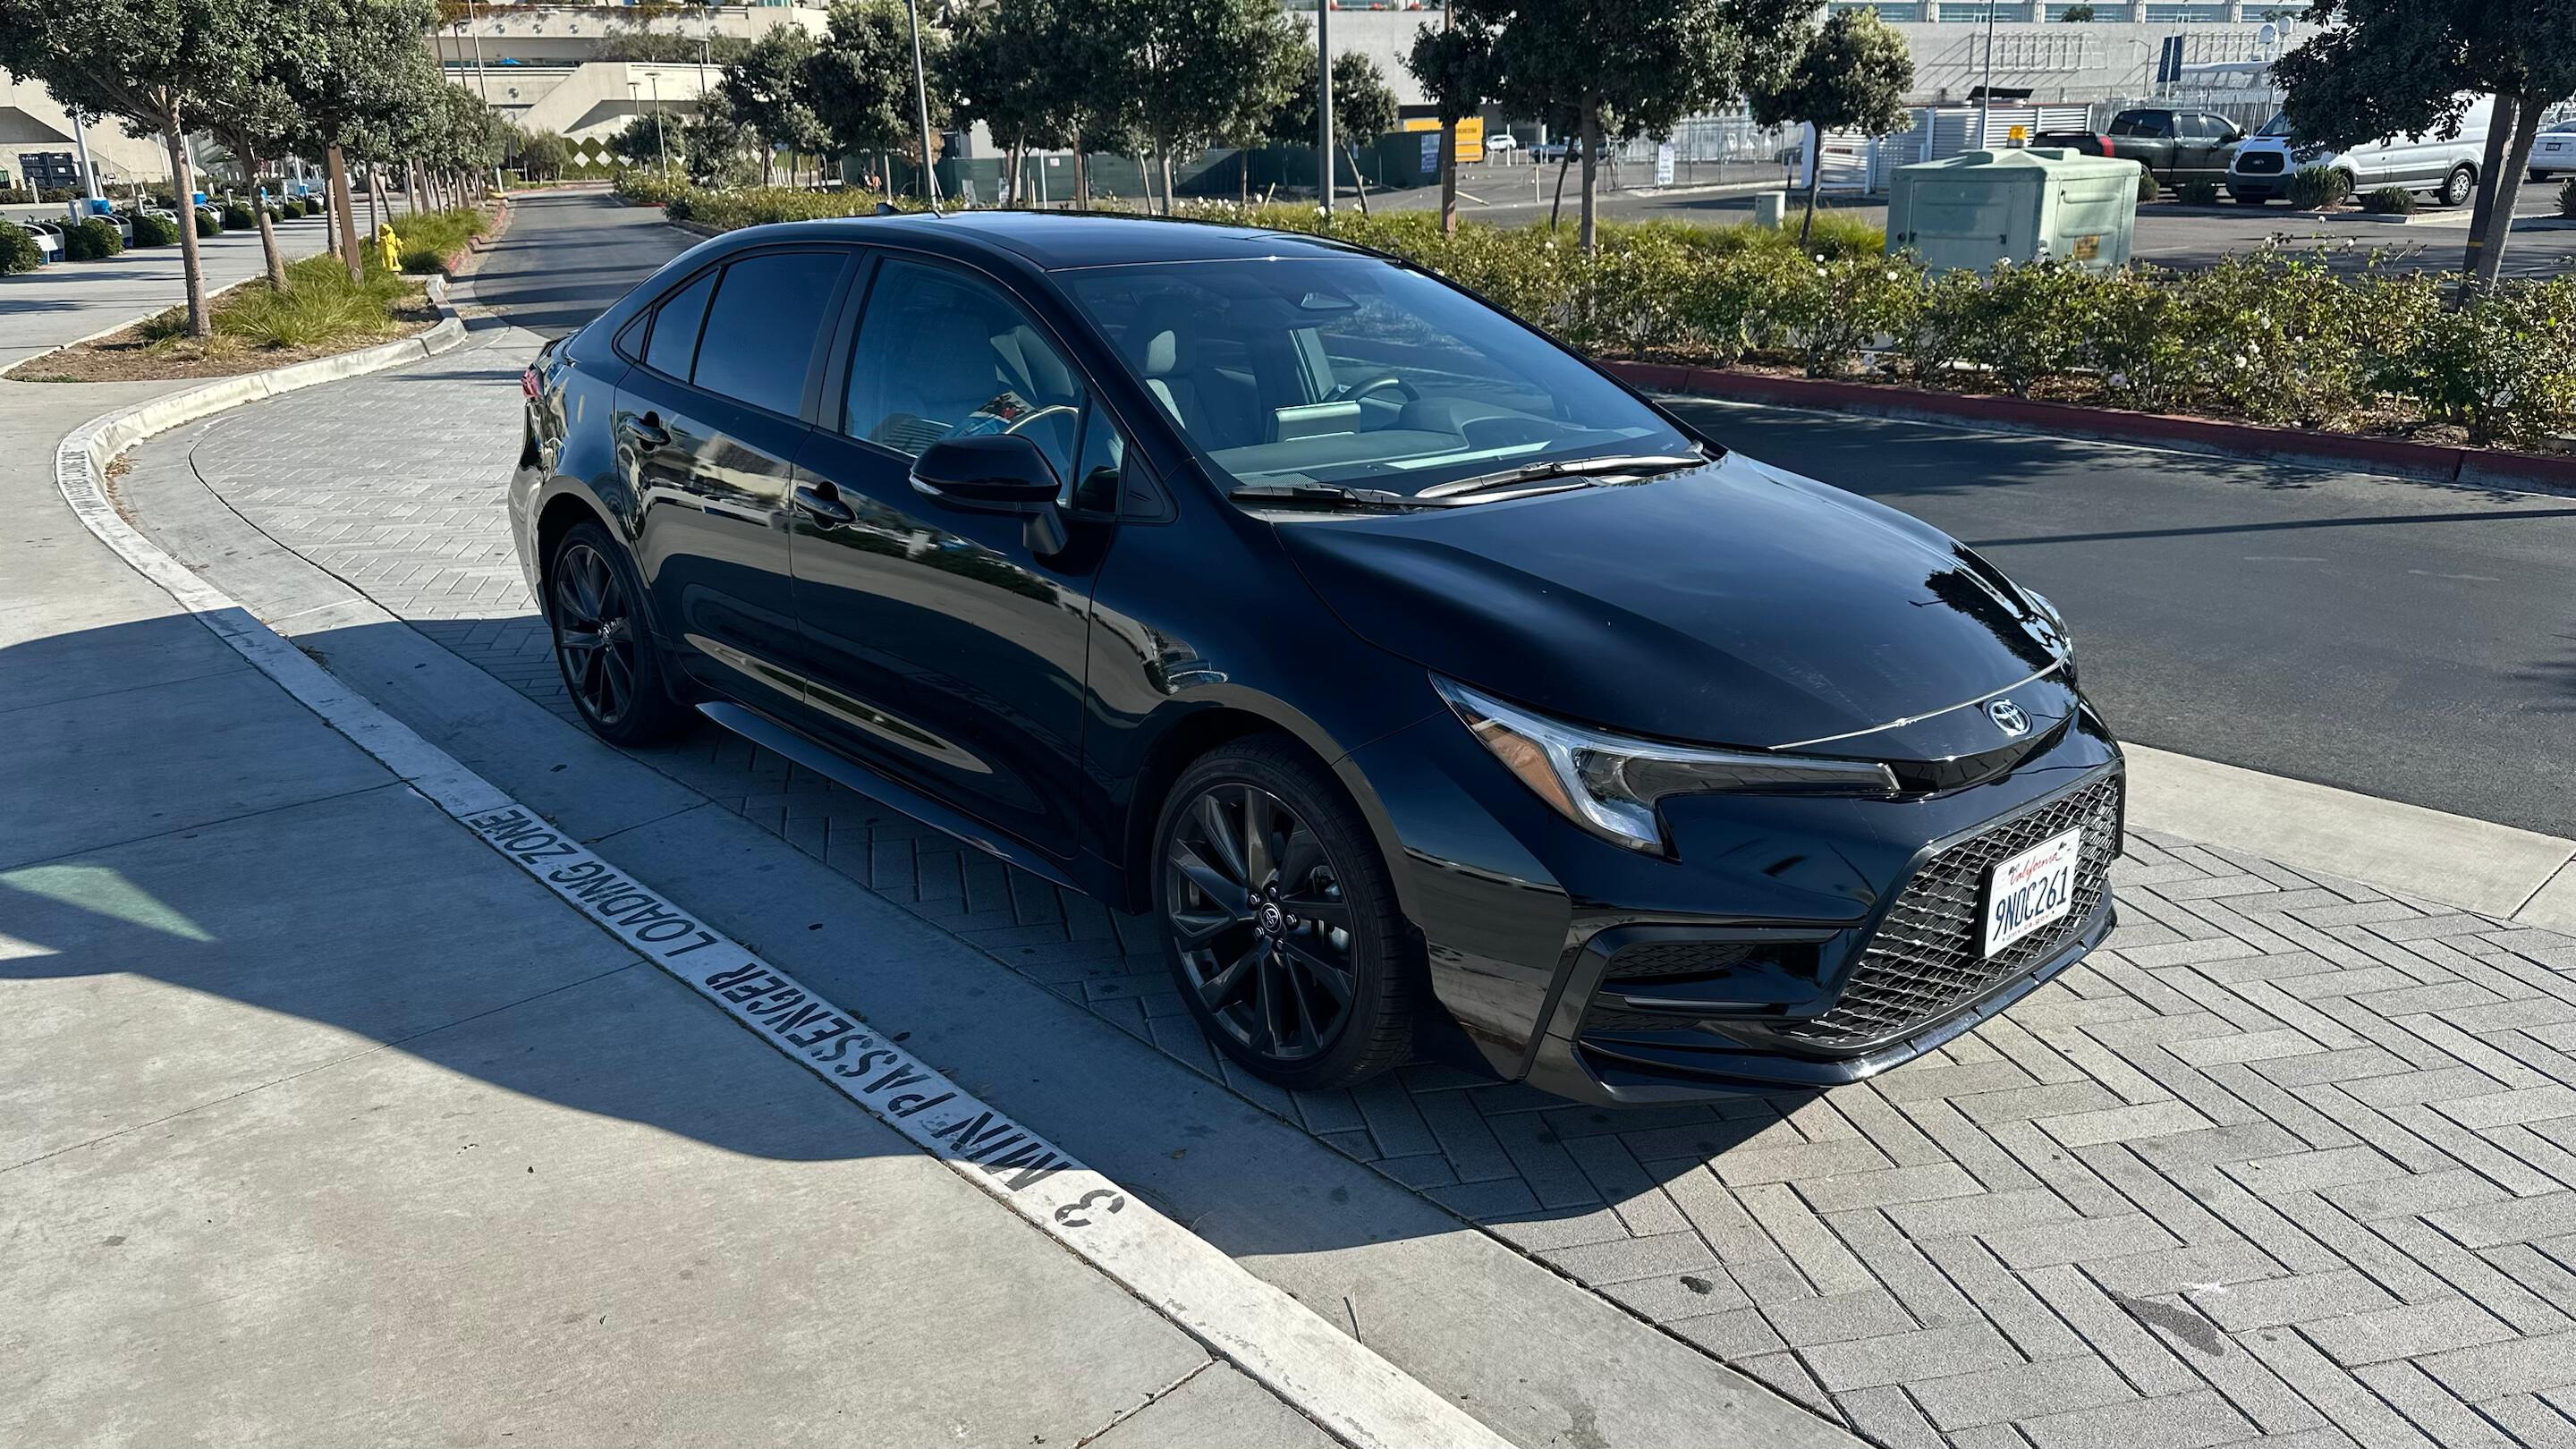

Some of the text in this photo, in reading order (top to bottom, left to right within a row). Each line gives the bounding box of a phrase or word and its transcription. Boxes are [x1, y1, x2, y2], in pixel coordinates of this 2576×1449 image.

[2010, 852, 2062, 886] California
[470, 809, 1125, 1227] 3 MIN PASSENGER LOADING ZONE
